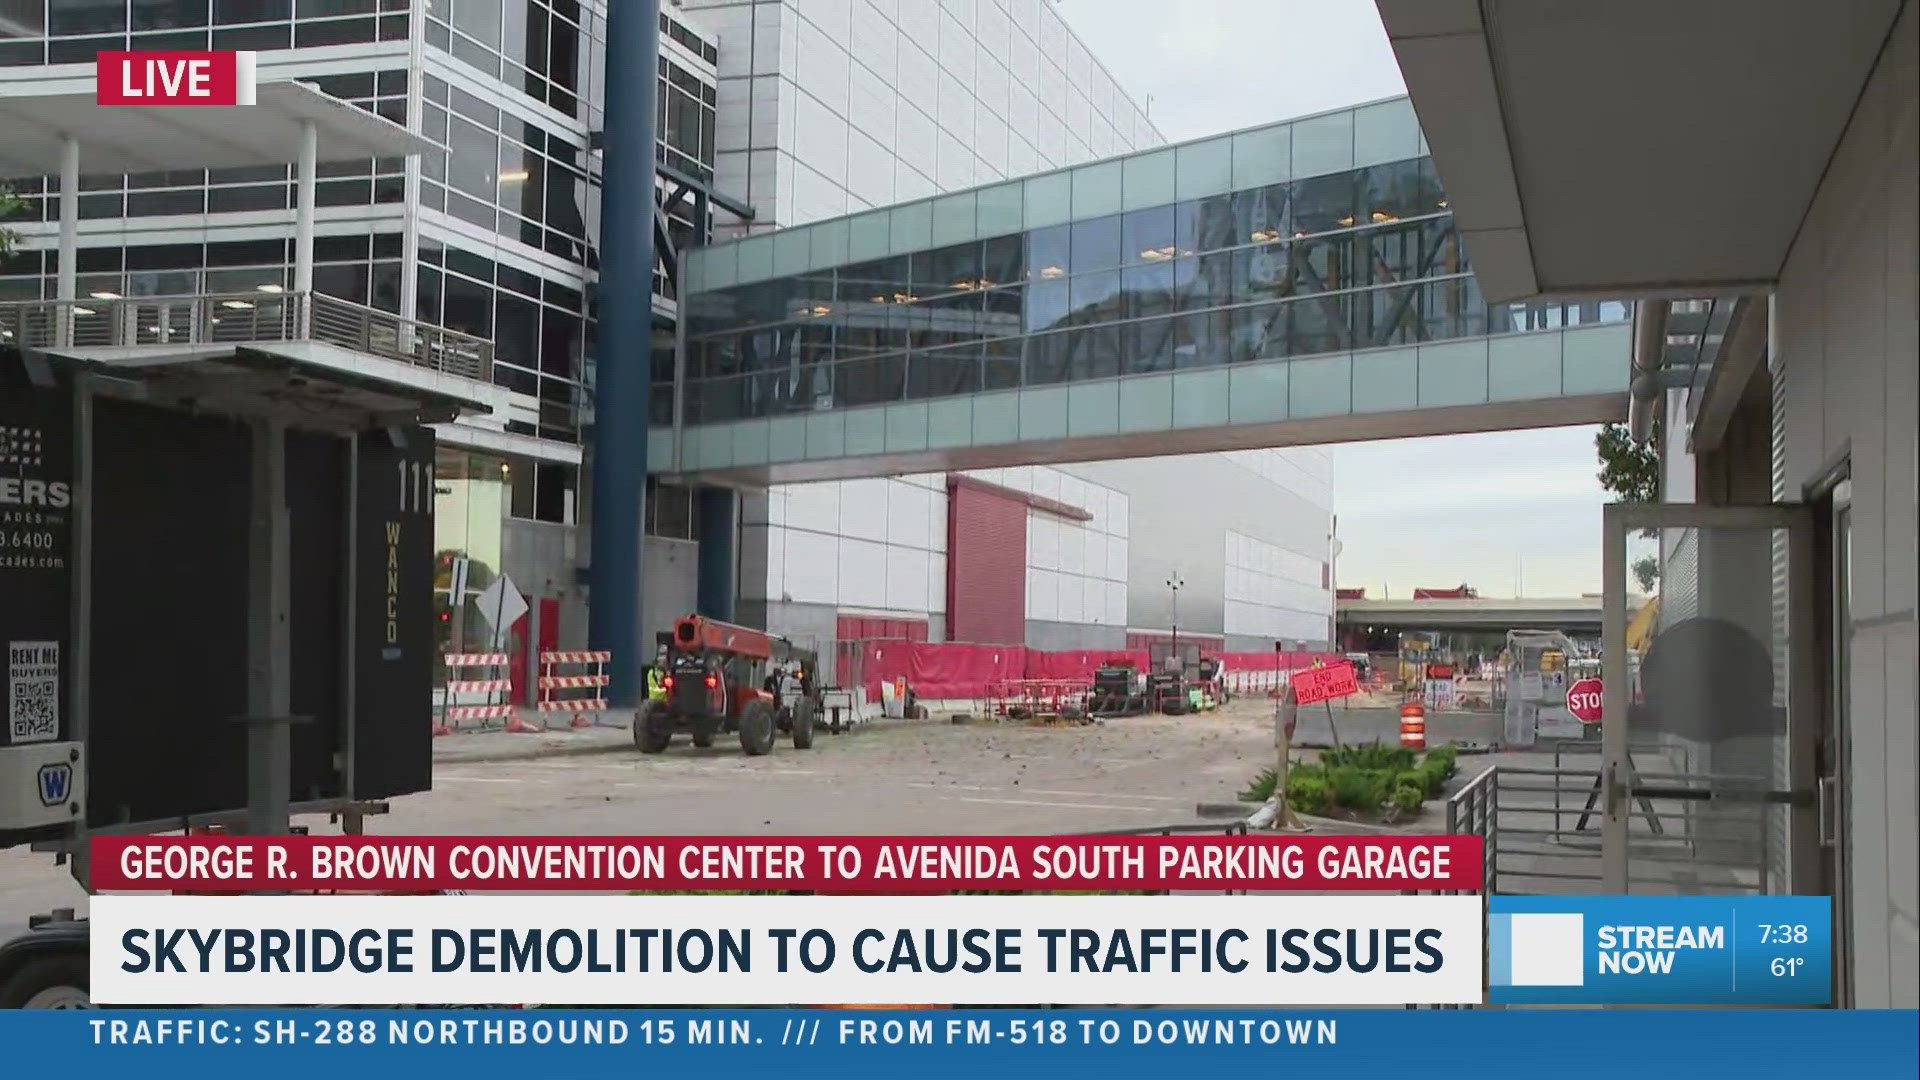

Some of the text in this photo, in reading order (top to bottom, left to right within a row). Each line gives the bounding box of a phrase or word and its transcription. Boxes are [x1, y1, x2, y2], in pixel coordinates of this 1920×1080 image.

[386, 521, 400, 643] WANCO
[12, 648, 57, 665] RENT ME
[1314, 671, 1331, 684] END
[1298, 680, 1354, 700] ROAD WORK
[43, 770, 67, 798] W
